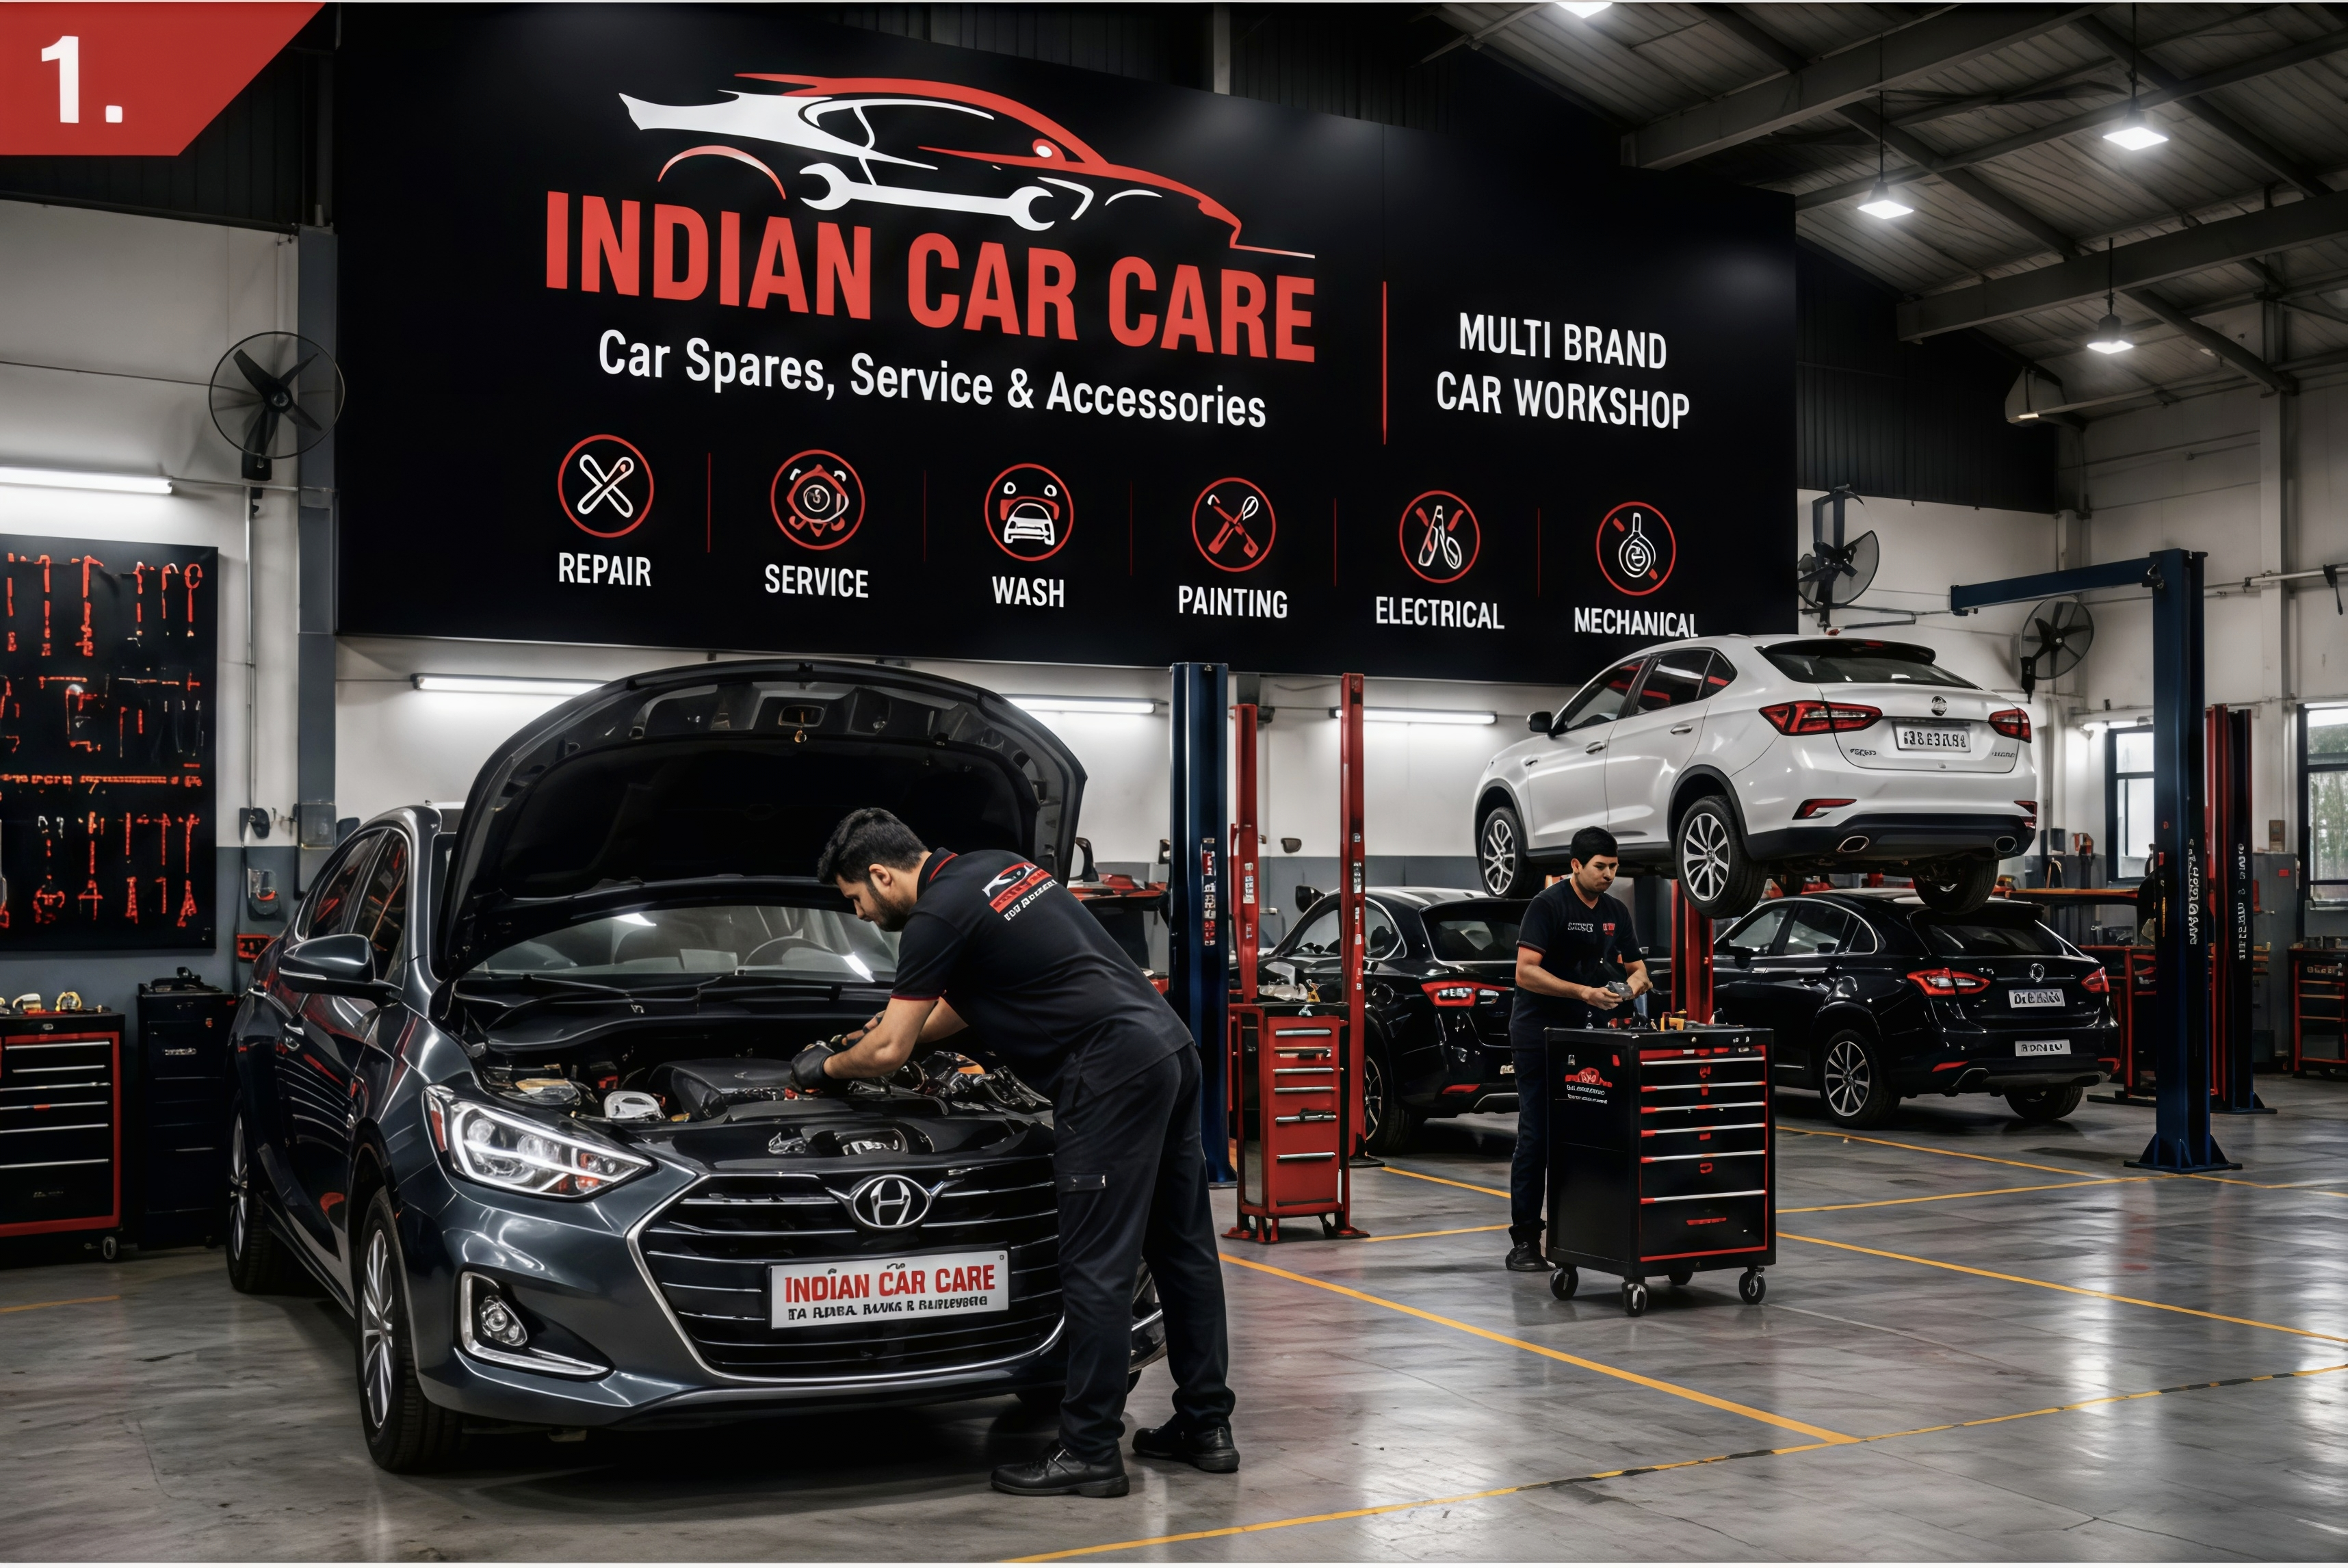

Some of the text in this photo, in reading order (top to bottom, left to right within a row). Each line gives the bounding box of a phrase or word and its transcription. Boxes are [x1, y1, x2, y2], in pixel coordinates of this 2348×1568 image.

[546, 190, 1316, 363] INDIAN CAR CARE
[1459, 311, 1667, 370] MULTI BRAND
[599, 329, 1266, 428] Car Spares, Service & Accessories
[1436, 370, 1691, 430] CAR WORKSHOP
[558, 551, 652, 588] REPAIR
[764, 563, 870, 599] SERVICE
[991, 575, 1065, 608] WASH
[1178, 585, 1288, 619] PAINTING
[1375, 595, 1506, 630] ELECTRICAL
[1574, 606, 1699, 638] MECHANICAL
[785, 1264, 995, 1303] INDIAN CAR CARE
